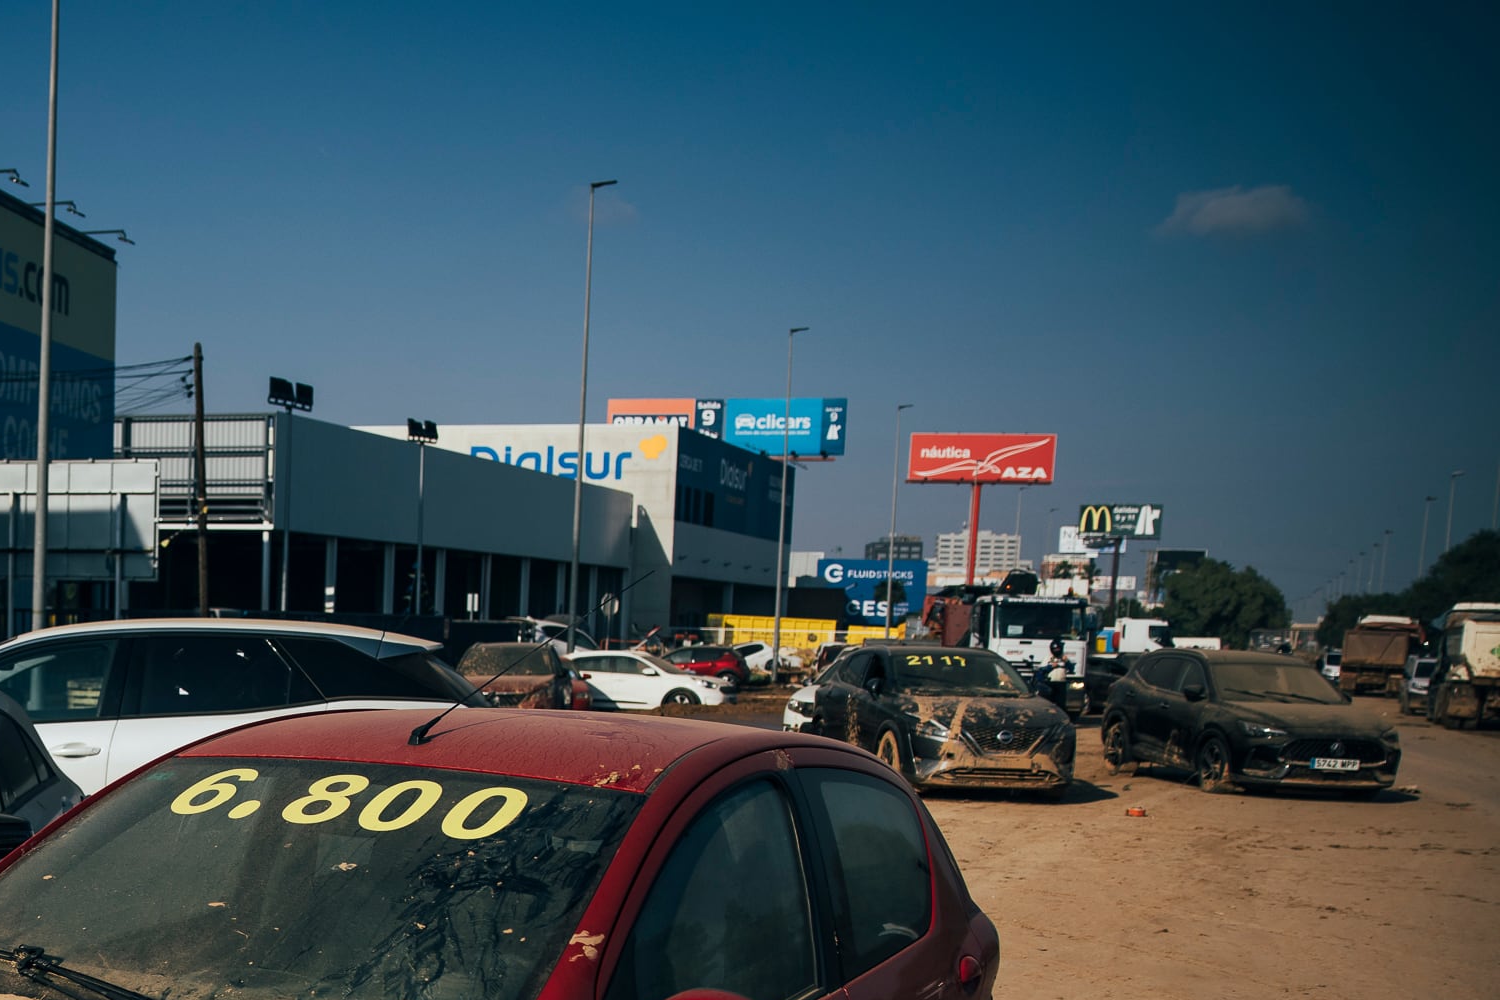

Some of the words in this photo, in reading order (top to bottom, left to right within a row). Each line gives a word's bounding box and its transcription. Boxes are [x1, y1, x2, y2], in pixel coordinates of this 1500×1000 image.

[702, 410, 715, 426] 9
[756, 413, 811, 429] clicars
[920, 446, 970, 459] náutica
[1001, 466, 1047, 479] AZA
[170, 768, 529, 840] 6.800
